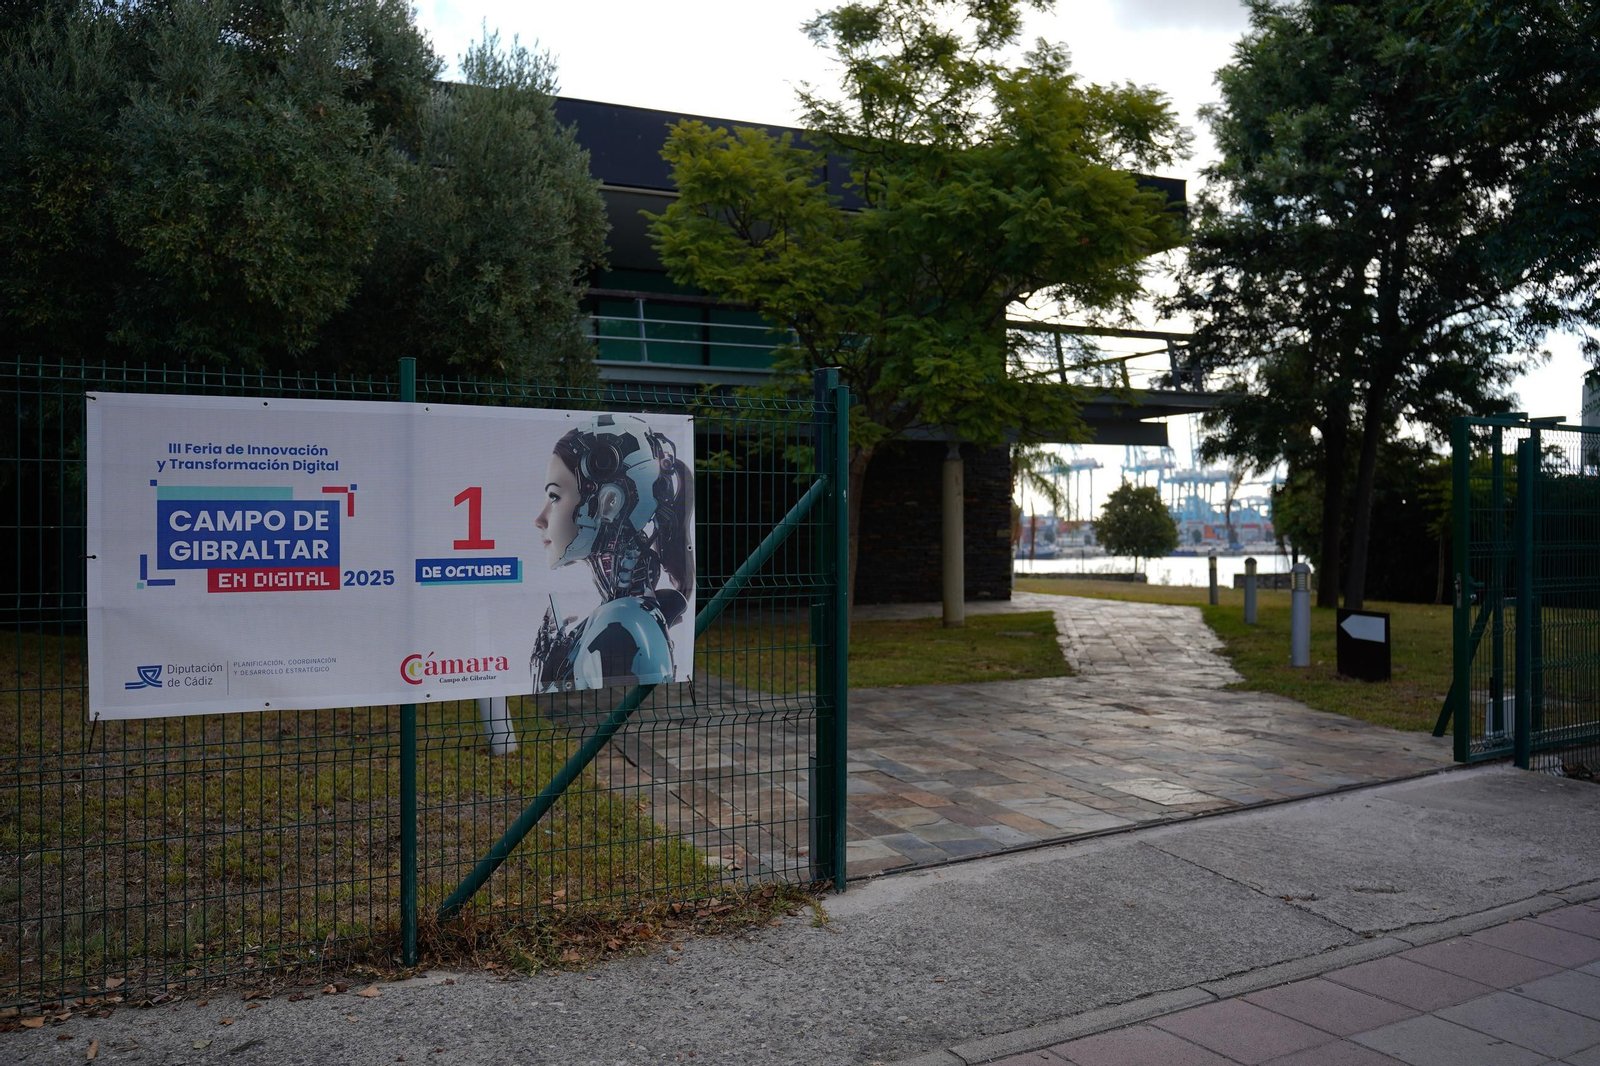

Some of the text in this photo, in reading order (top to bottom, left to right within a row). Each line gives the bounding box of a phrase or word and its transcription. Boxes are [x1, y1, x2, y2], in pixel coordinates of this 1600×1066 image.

[168, 443, 328, 456] III Feria de Innovación
[156, 458, 339, 474] y Transformación Digital
[169, 510, 329, 532] CAMPO DE
[453, 486, 495, 550] 1
[169, 539, 329, 561] GIBRALTAR
[344, 570, 395, 587] 2025
[422, 564, 512, 579] DE OCTUBRE
[218, 571, 330, 588] EN DIGITAL
[167, 663, 223, 675] Diputación
[233, 657, 337, 668] PLANIFICACIÓN, COORDINACIÓN
[240, 668, 283, 676] DESARROLLO
[286, 665, 330, 674] ESTRATÉGICO
[167, 676, 213, 688] de Cádiz
